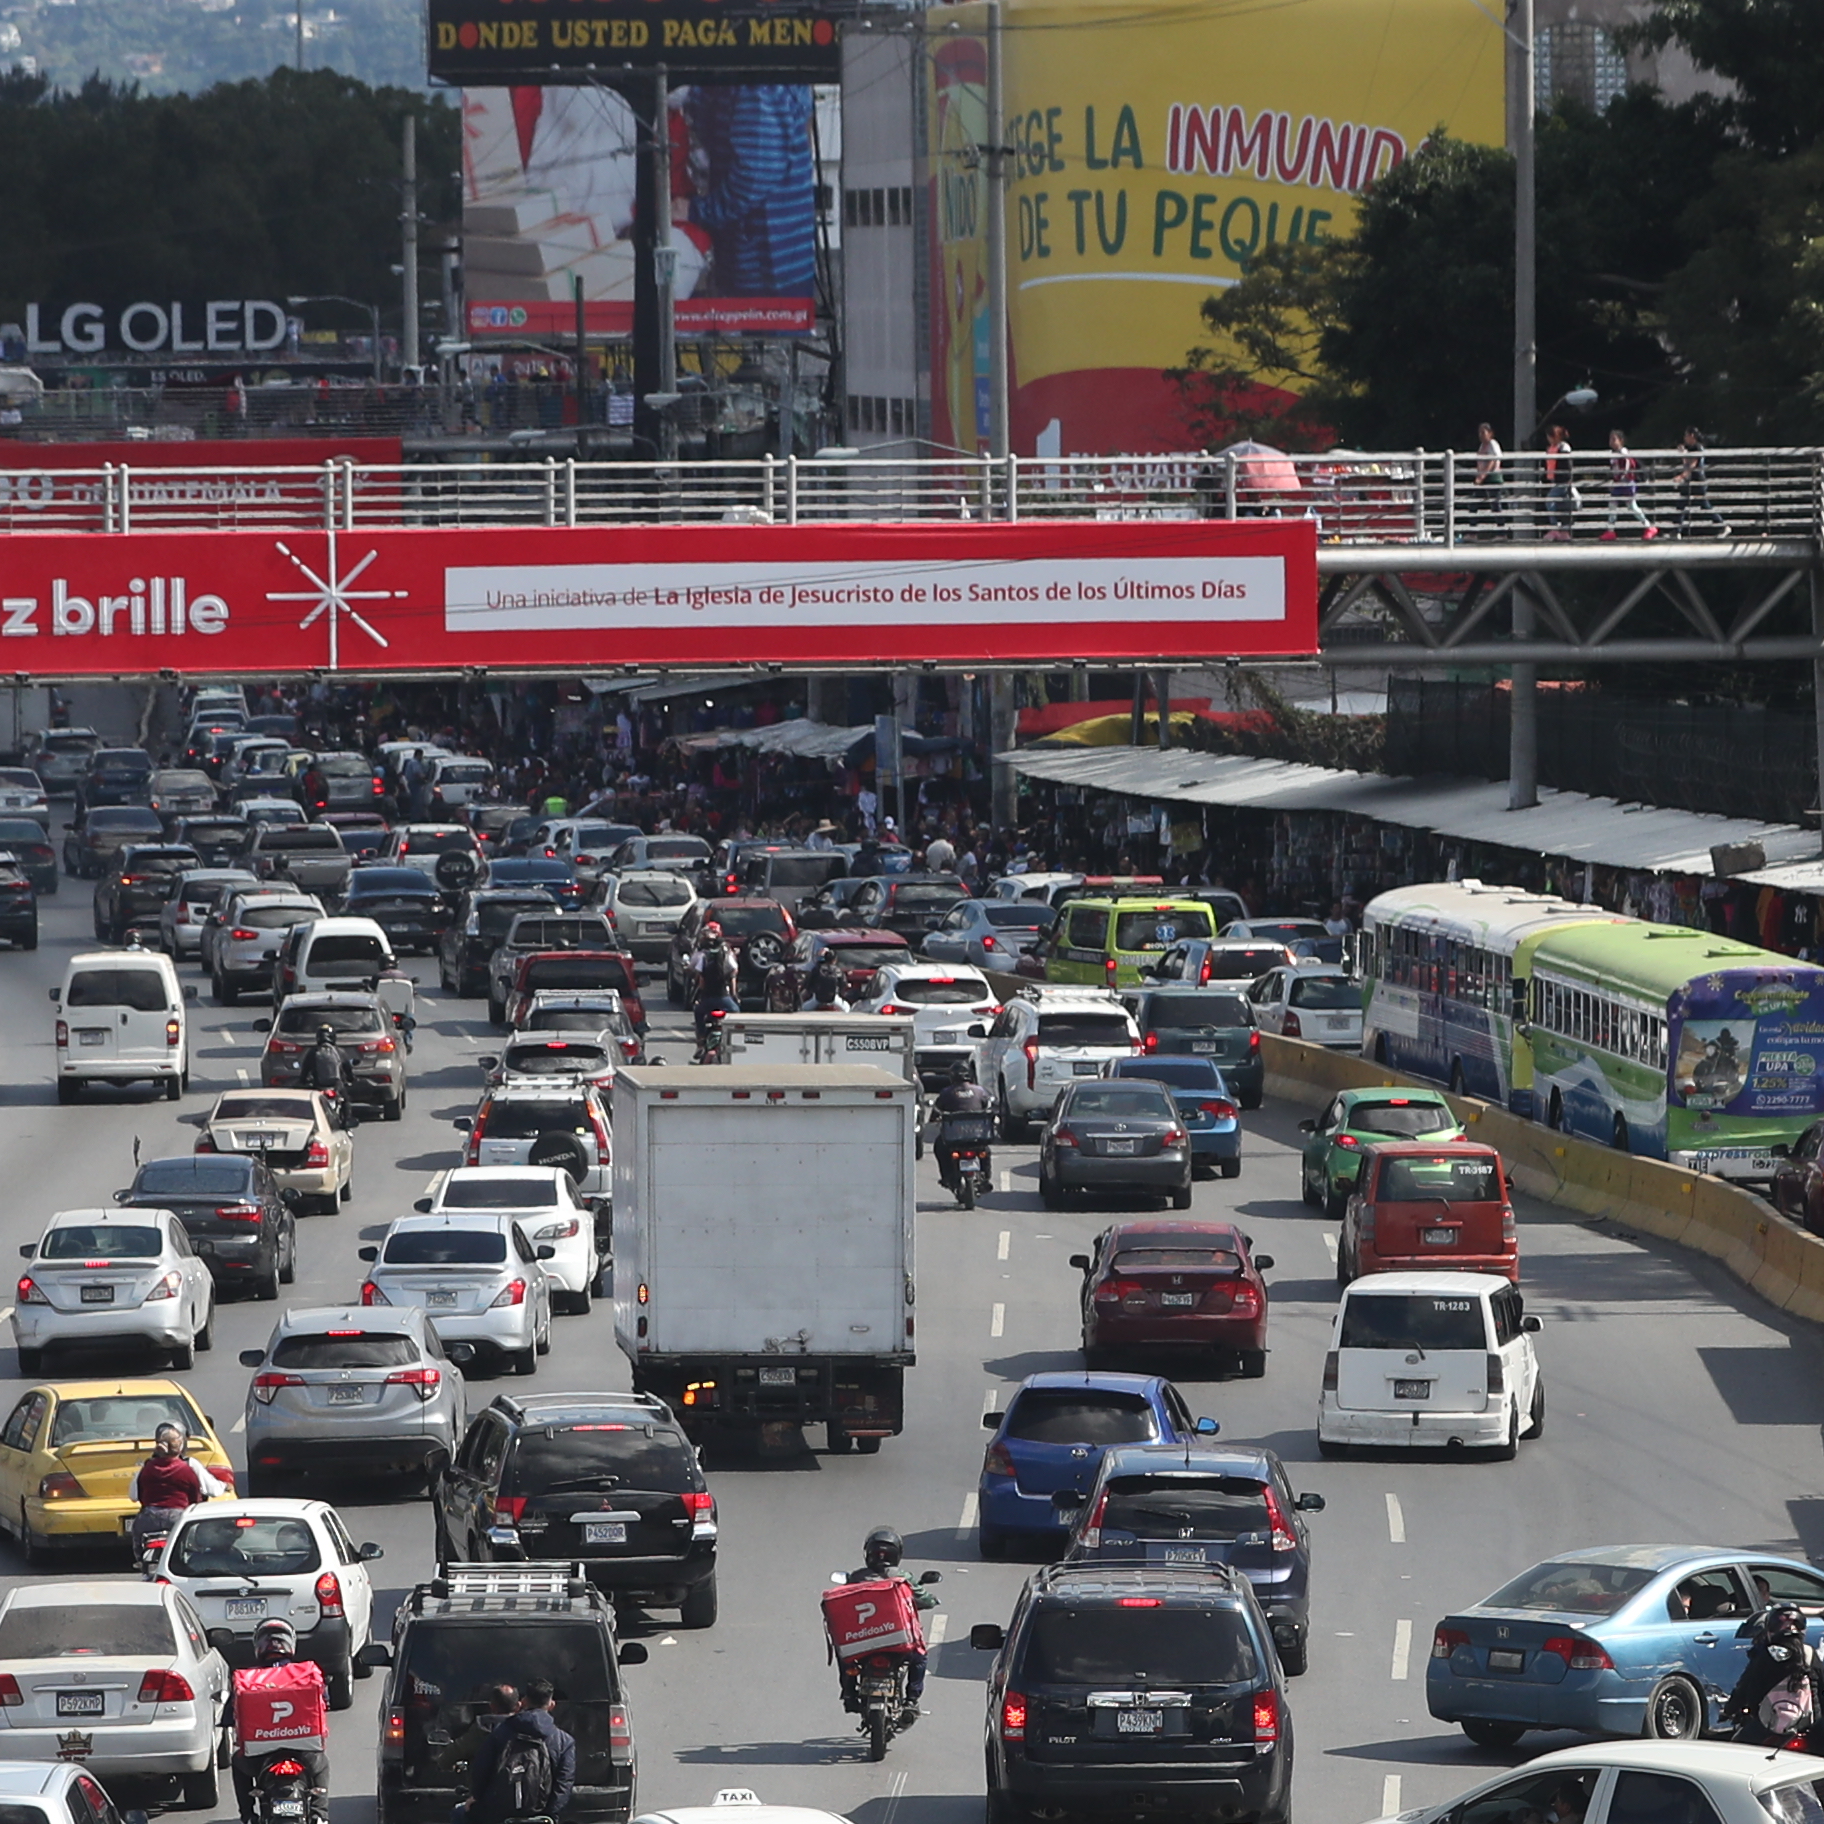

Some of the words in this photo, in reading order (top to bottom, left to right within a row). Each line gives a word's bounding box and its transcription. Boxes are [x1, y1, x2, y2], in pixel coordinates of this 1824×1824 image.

[437, 20, 538, 49] DONDE
[551, 20, 650, 48] USTED
[663, 18, 736, 48] PAGA
[1085, 103, 1144, 169] LA
[1166, 102, 1416, 196] INMUNID
[1019, 192, 1051, 261] DE
[1067, 188, 1127, 255] TU
[26, 302, 106, 352] LG
[119, 299, 287, 352] OLED
[486, 589, 526, 608] Una
[531, 587, 610, 607] iniciativa
[614, 587, 648, 606] de
[653, 586, 681, 605] La
[685, 584, 754, 610] Iglesia
[759, 584, 784, 604] de
[788, 583, 896, 608] Jesucristo
[900, 582, 927, 602] de
[932, 581, 963, 602] los
[968, 581, 1041, 602] Santos
[1045, 580, 1072, 601] de
[1077, 580, 1108, 601] los
[1112, 576, 1196, 601] Últimos
[1201, 578, 1247, 600] Días
[52, 576, 230, 635] brille
[1765, 1061, 1789, 1072] UPA
[537, 1151, 577, 1165] HONDA
[1432, 1300, 1471, 1312] TR-1283
[845, 1622, 896, 1642] PedidosYa
[254, 1726, 312, 1739] PedidosYa
[1048, 1736, 1077, 1744] PILOT
[720, 1793, 753, 1803] TAXI
